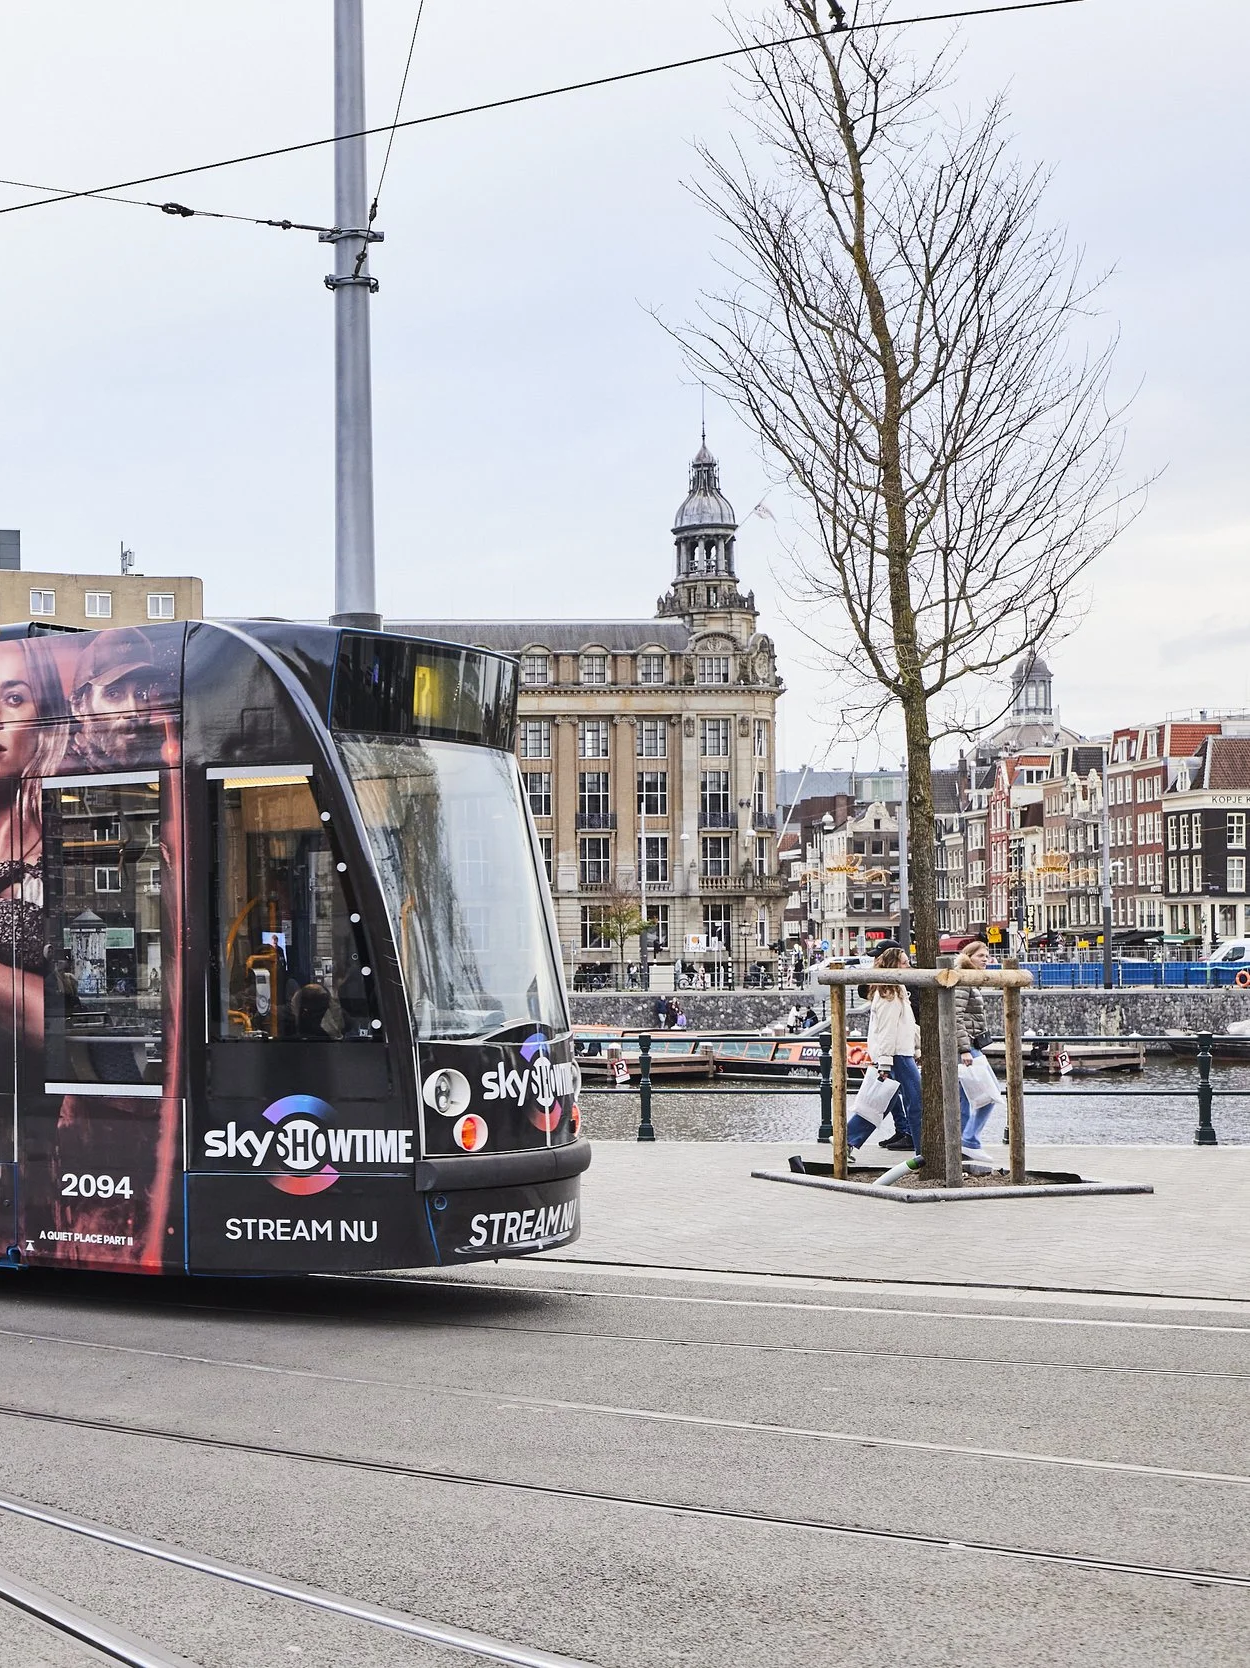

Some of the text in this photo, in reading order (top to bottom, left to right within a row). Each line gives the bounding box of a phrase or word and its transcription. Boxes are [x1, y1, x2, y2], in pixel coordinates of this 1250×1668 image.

[61, 1173, 134, 1200] 2094
[225, 1217, 378, 1243] STREAM NU
[468, 1198, 578, 1247] STREAM NU
[39, 1230, 134, 1246] A QUIET PLACE PART II
